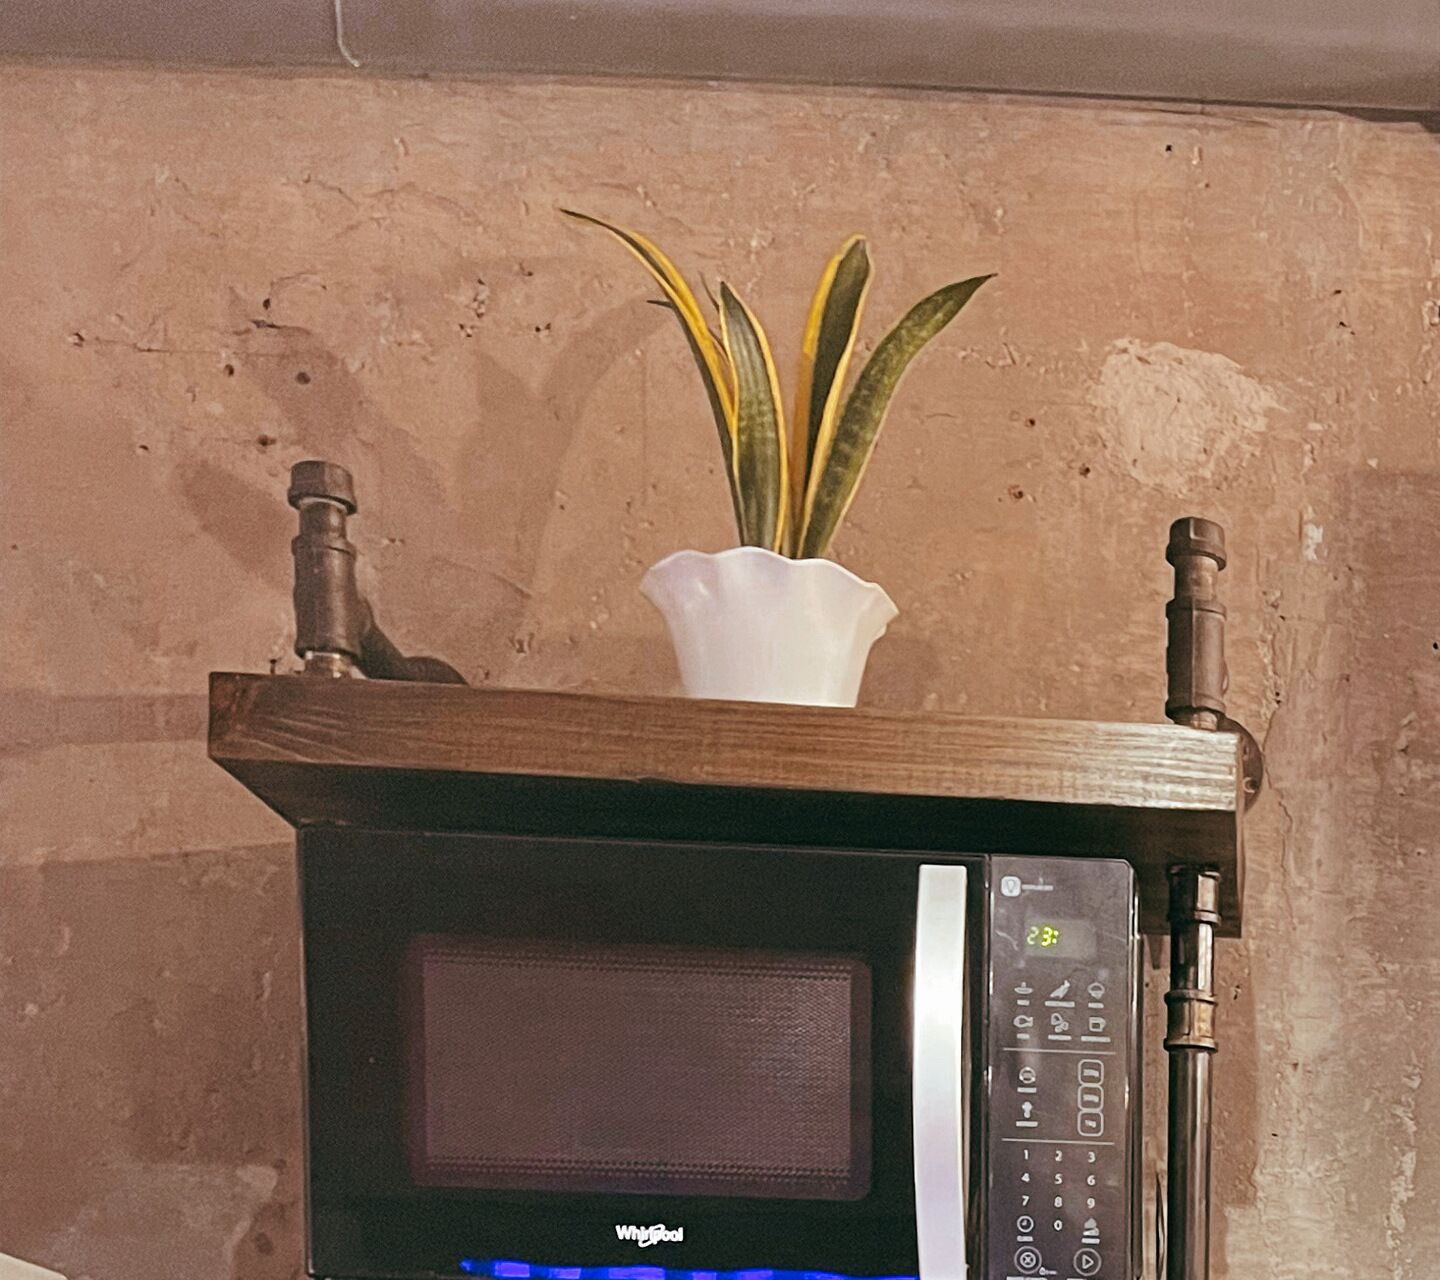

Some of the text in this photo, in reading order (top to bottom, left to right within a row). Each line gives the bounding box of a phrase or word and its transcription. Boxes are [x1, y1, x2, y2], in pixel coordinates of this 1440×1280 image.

[1023, 1150, 1095, 1163] 1 2 3
[1021, 1172, 1095, 1186] 4 5 6
[1022, 1195, 1095, 1208] 7 8 9
[615, 1224, 684, 1248] Whirlpool
